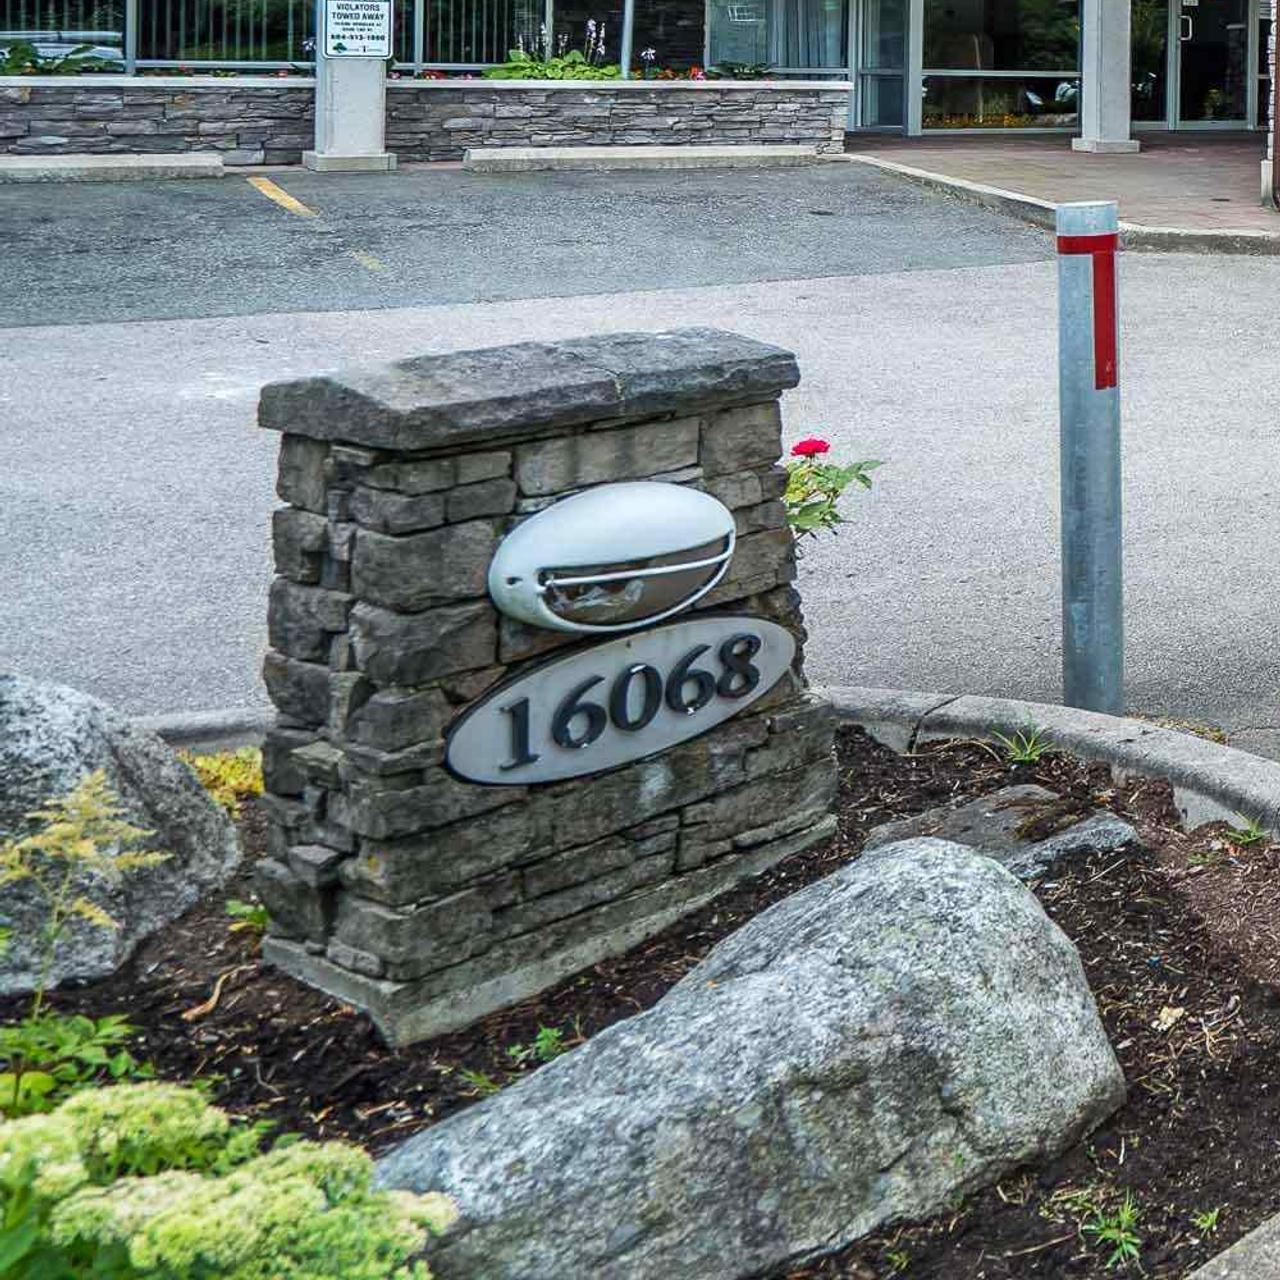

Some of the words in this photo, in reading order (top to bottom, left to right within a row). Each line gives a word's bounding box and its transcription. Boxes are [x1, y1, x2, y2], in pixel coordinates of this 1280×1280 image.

[336, 3, 380, 12] VIOLATORS
[331, 12, 361, 20] TOWED
[362, 12, 384, 21] AWAY
[499, 633, 762, 771] 16068
